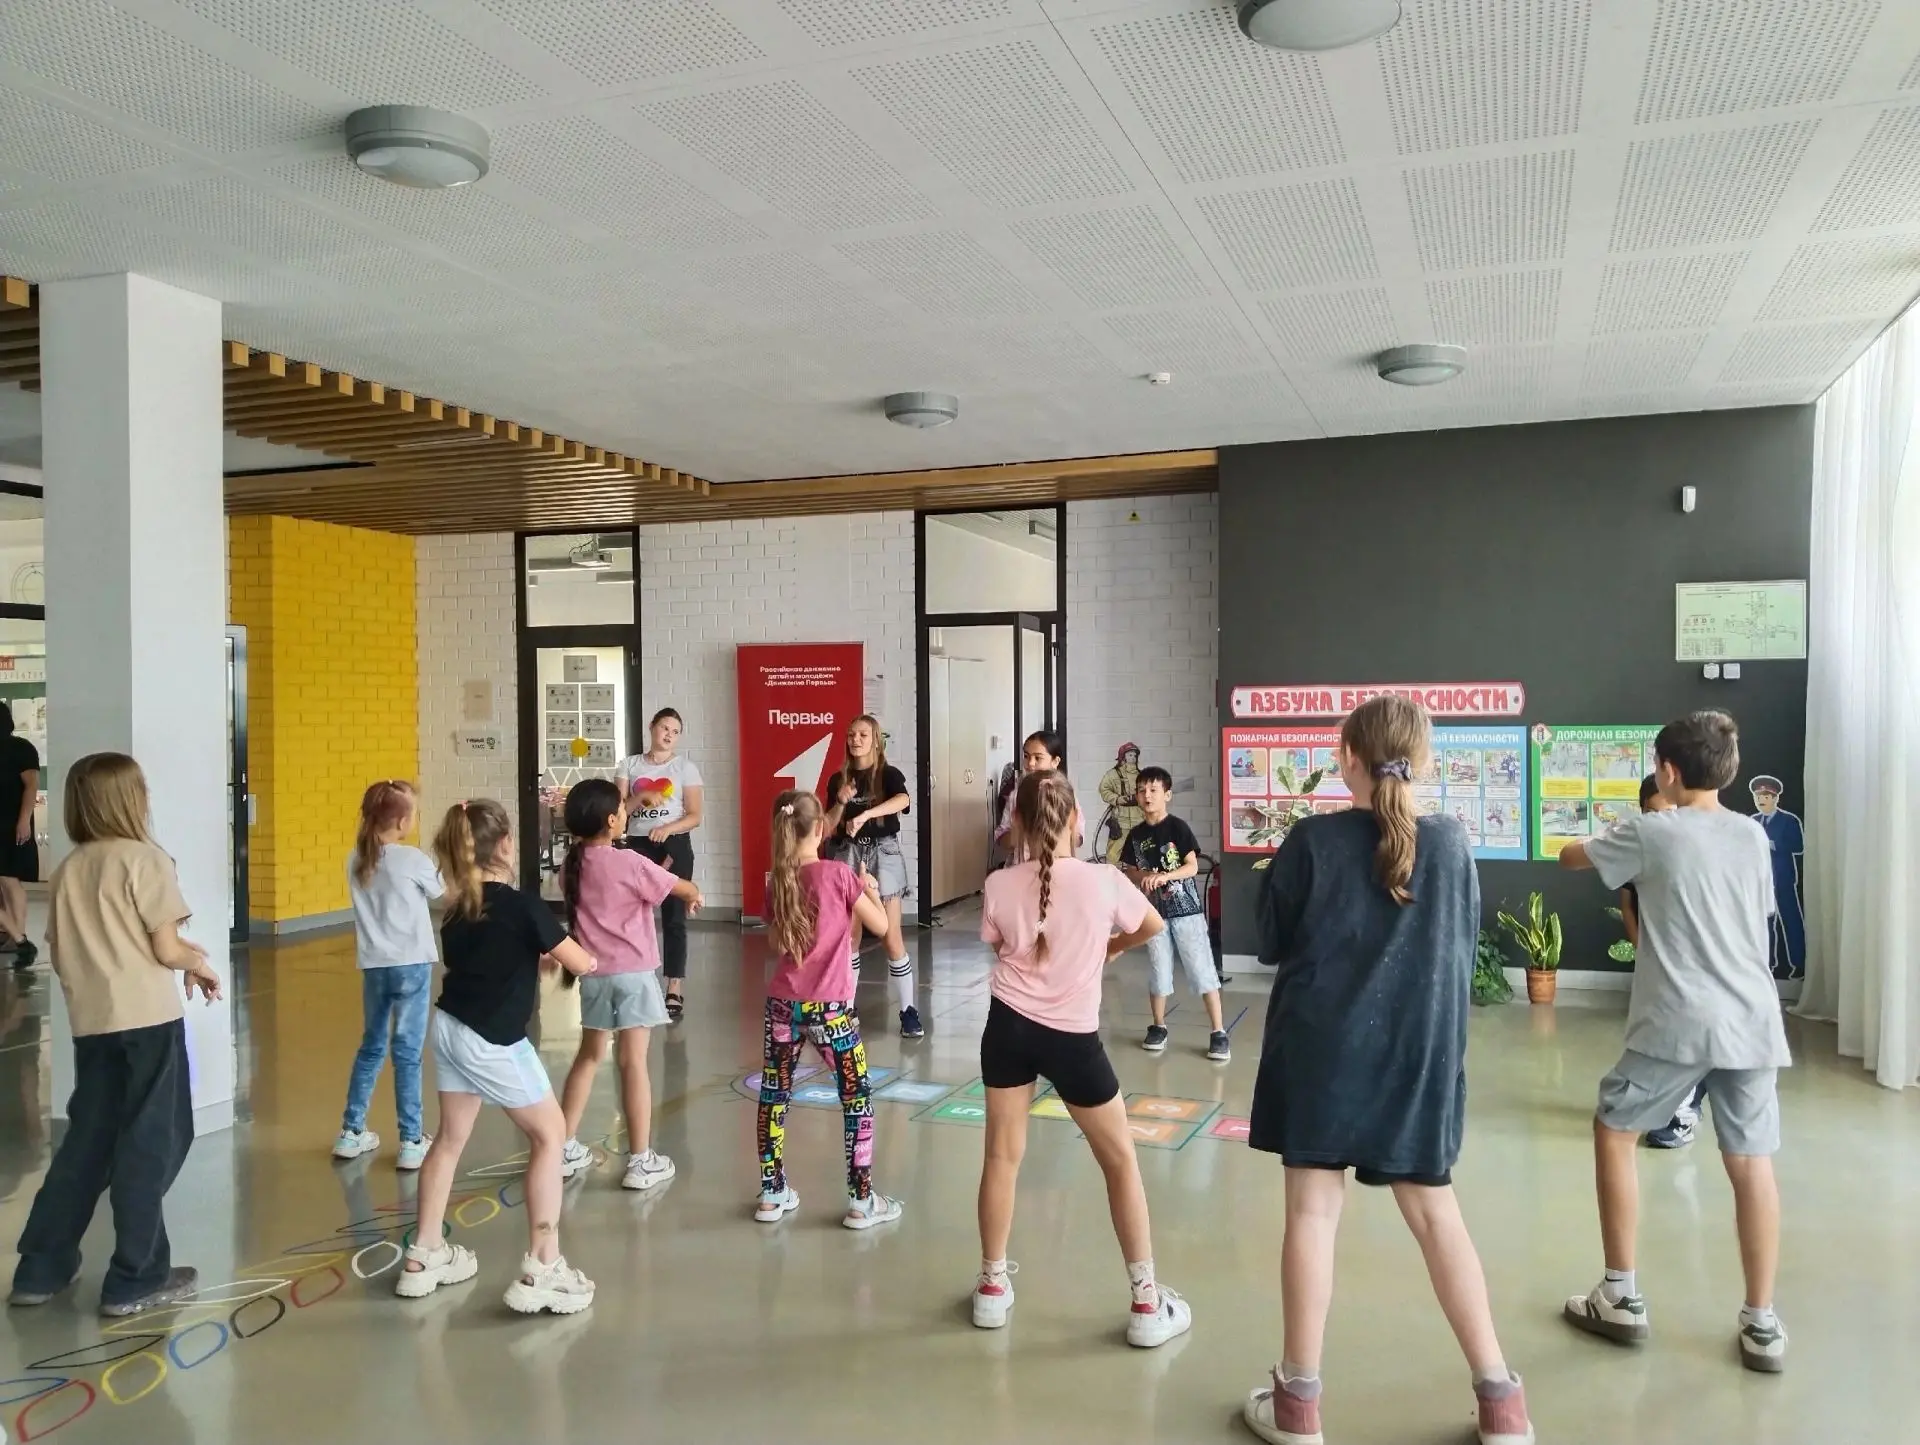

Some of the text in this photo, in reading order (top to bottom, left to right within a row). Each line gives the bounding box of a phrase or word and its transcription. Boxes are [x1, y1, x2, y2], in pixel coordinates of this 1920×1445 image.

[1250, 691, 1334, 712] АЗБУКА
[768, 709, 834, 730] Первые
[1230, 733, 1279, 743] ПОЖАРНАЯ
[1449, 733, 1519, 744] БЕЗОПАСНОСТИ
[1556, 730, 1613, 741] ДОРОЖНАЯ
